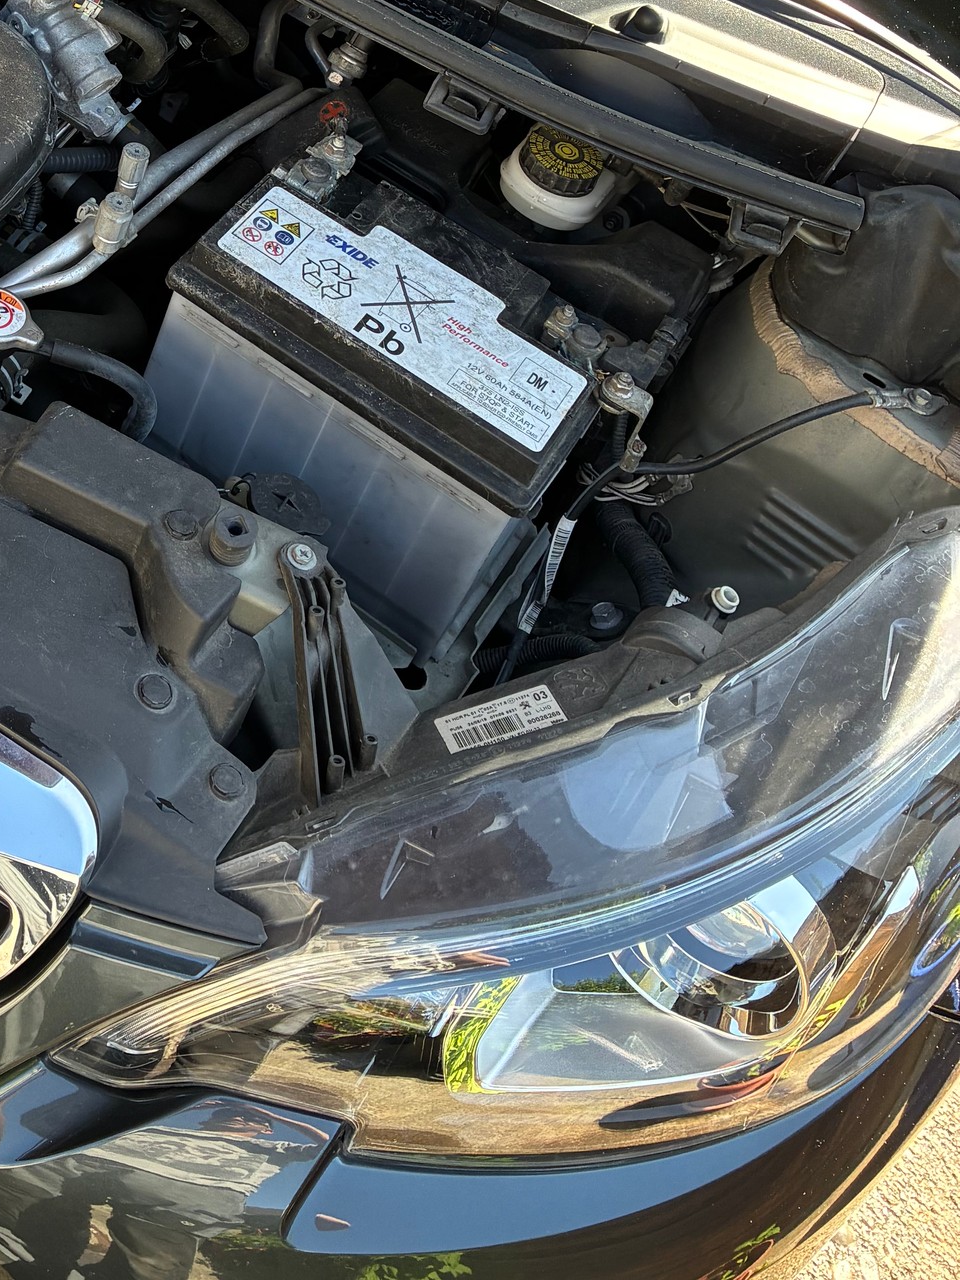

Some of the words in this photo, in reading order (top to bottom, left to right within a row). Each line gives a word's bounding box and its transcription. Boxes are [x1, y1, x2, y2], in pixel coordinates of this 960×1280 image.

[325, 234, 380, 269] EXIDE
[353, 313, 405, 355] Pb
[447, 316, 473, 335] High
[442, 323, 509, 368] Performance
[466, 362, 483, 376] 12V
[485, 373, 508, 392] 60Ah
[526, 372, 549, 392] DM
[460, 380, 478, 395] FOR
[478, 391, 502, 408] STOP
[509, 410, 536, 431] START
[533, 690, 548, 701] 03
